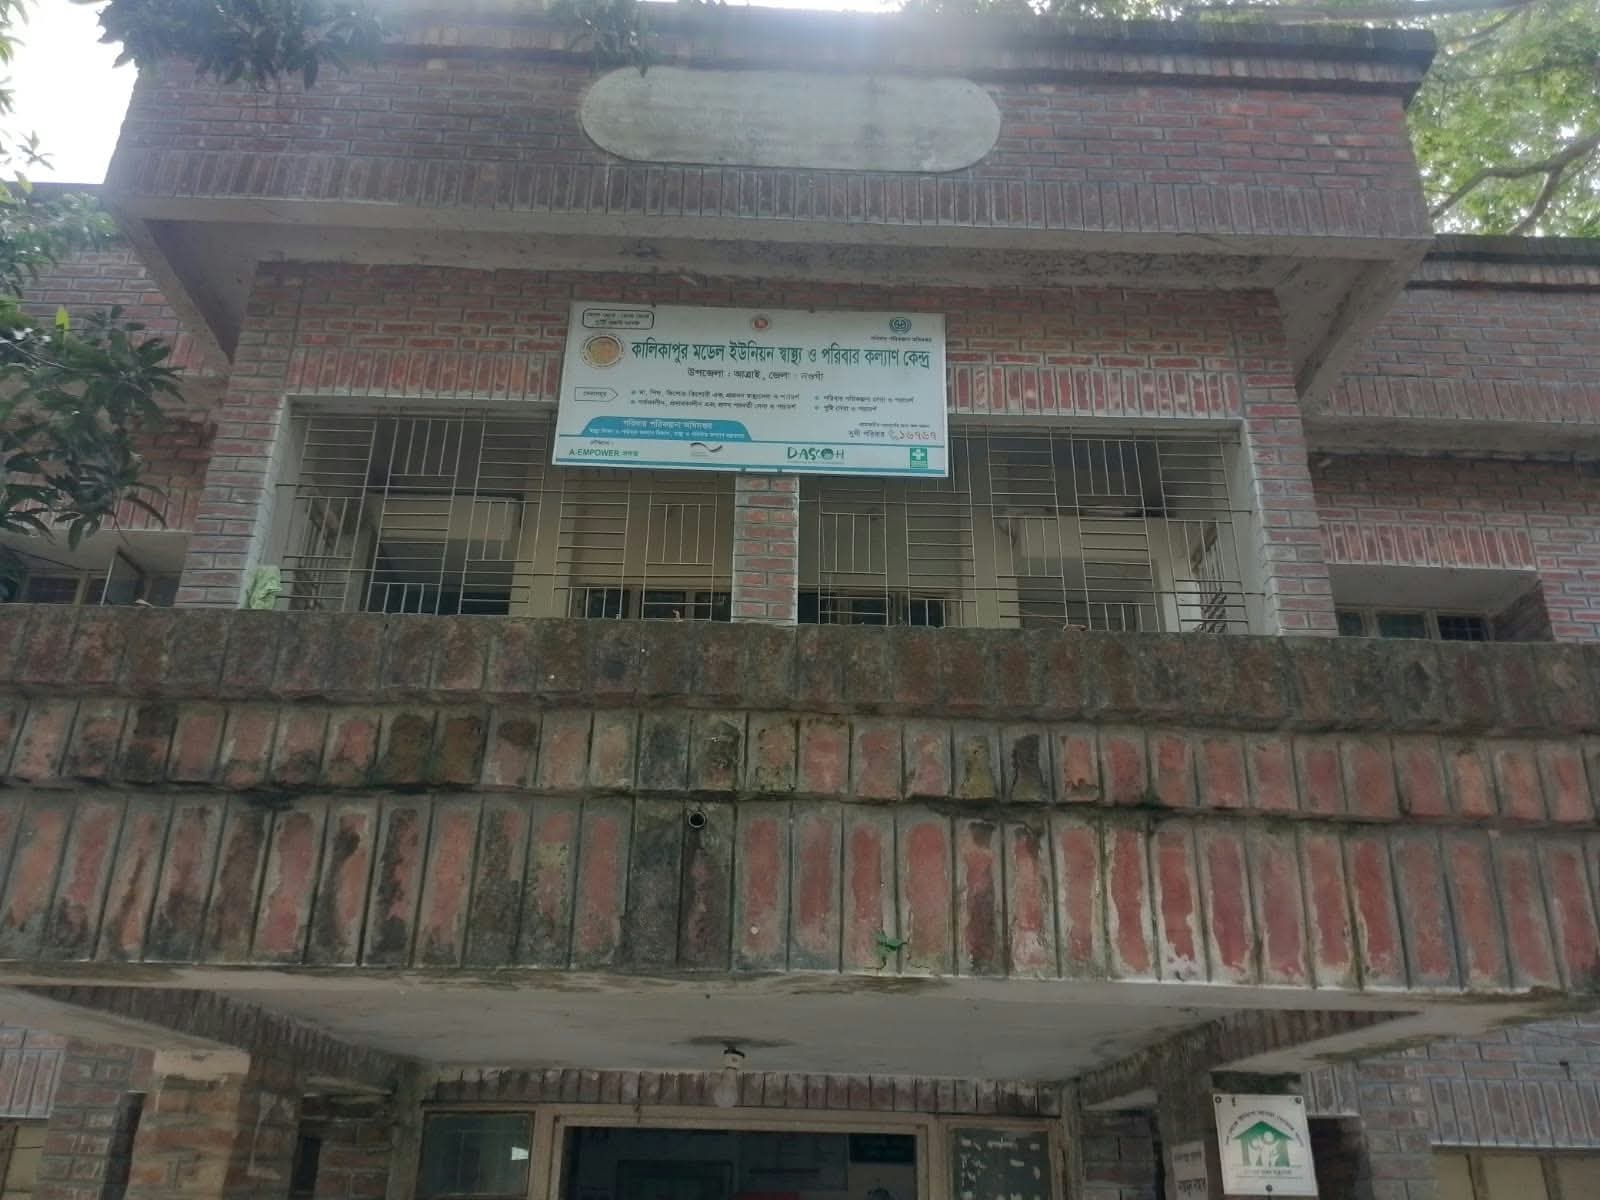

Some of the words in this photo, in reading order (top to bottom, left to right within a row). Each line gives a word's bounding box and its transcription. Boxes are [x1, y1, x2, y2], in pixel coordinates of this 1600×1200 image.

[631, 337, 688, 363] কালিকাপুর
[692, 343, 725, 361] মডেল
[729, 339, 774, 361] ইউনিয়ন
[778, 347, 803, 366] স্বাস্থ্য
[808, 349, 817, 362] ও
[822, 342, 860, 365] পরিবার
[864, 349, 900, 367] কল্যাণ
[903, 350, 932, 369] কেন্দ্র
